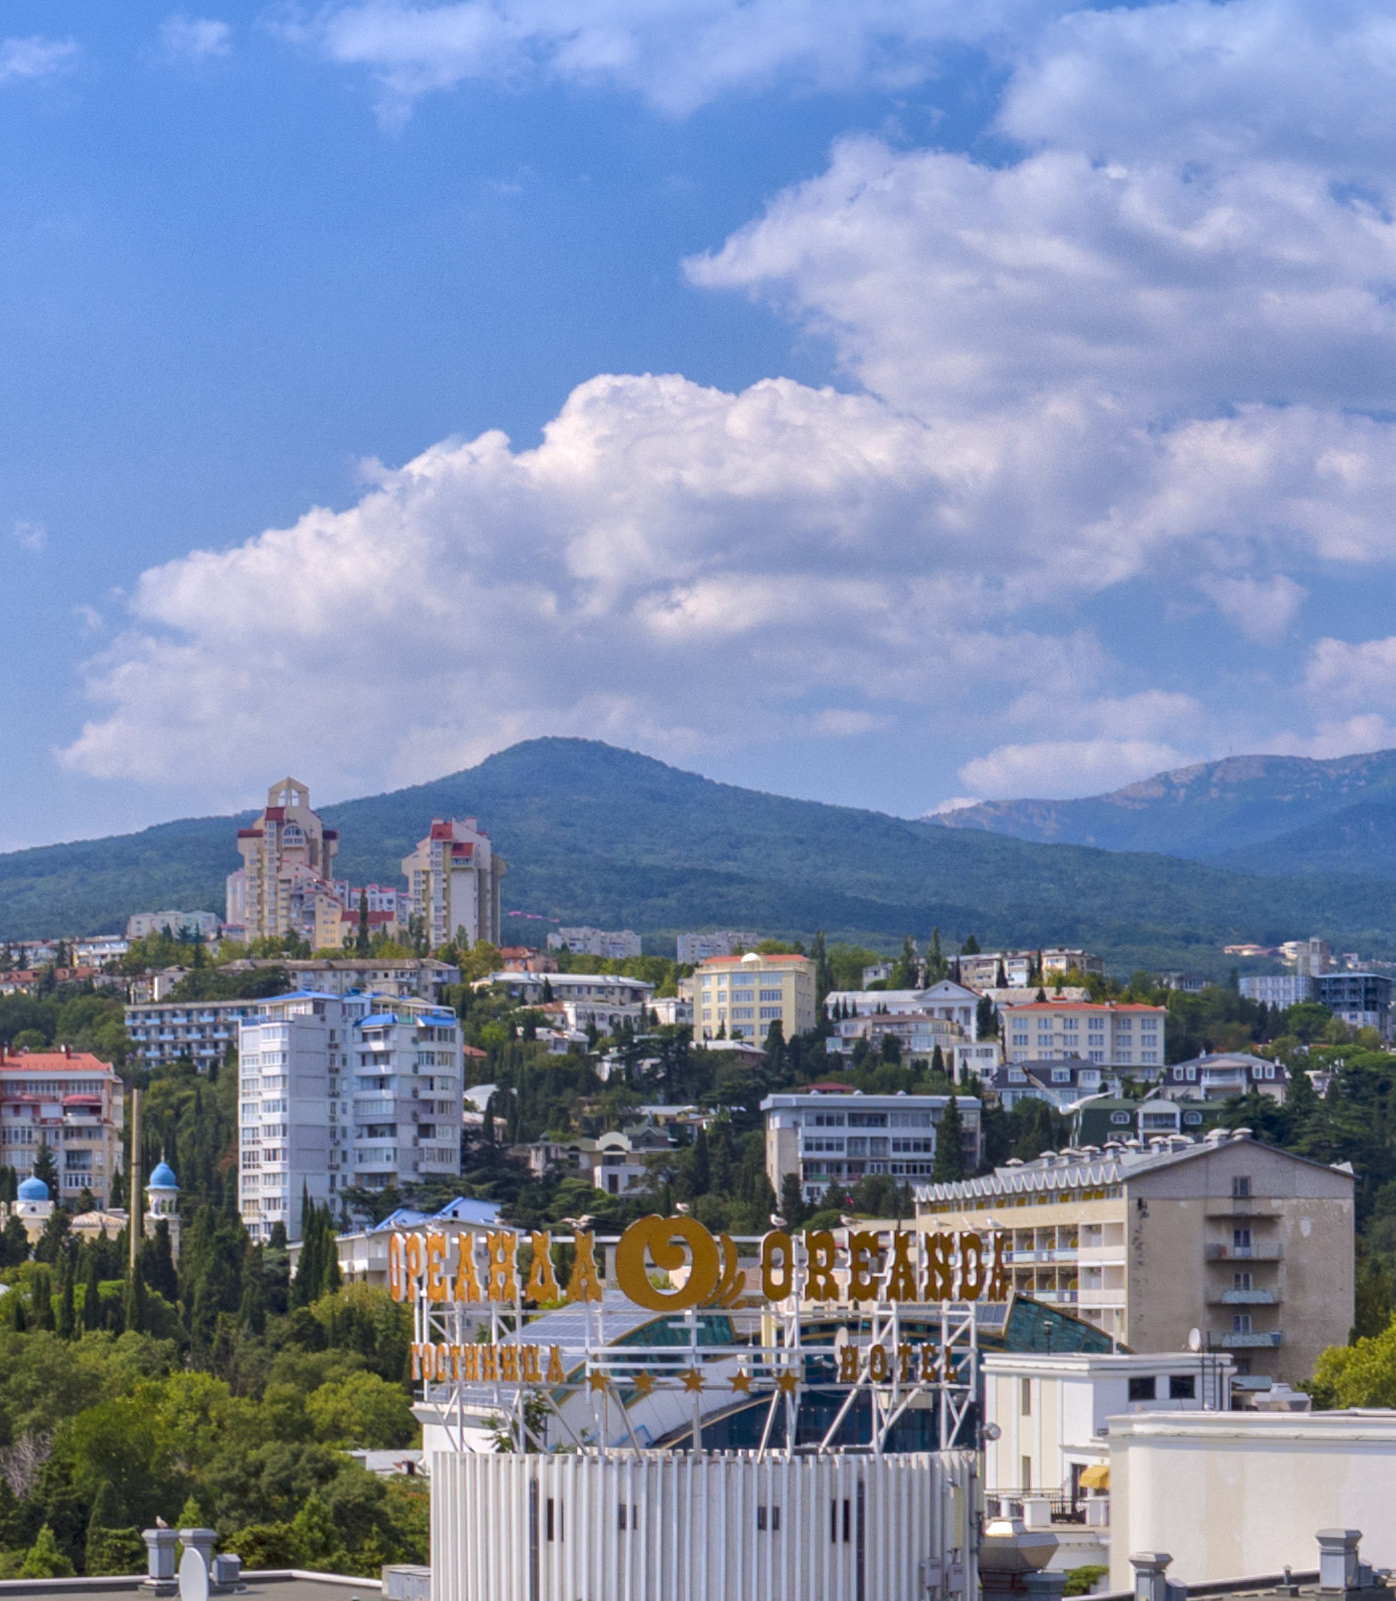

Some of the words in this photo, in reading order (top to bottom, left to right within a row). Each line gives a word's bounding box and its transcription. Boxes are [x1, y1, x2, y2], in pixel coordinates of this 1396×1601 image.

[389, 1229, 604, 1303] ОРЕАНДА
[759, 1228, 1008, 1303] OREANDA
[410, 1341, 567, 1383] ГОСТИНИЦА
[838, 1342, 959, 1383] HOTEL
